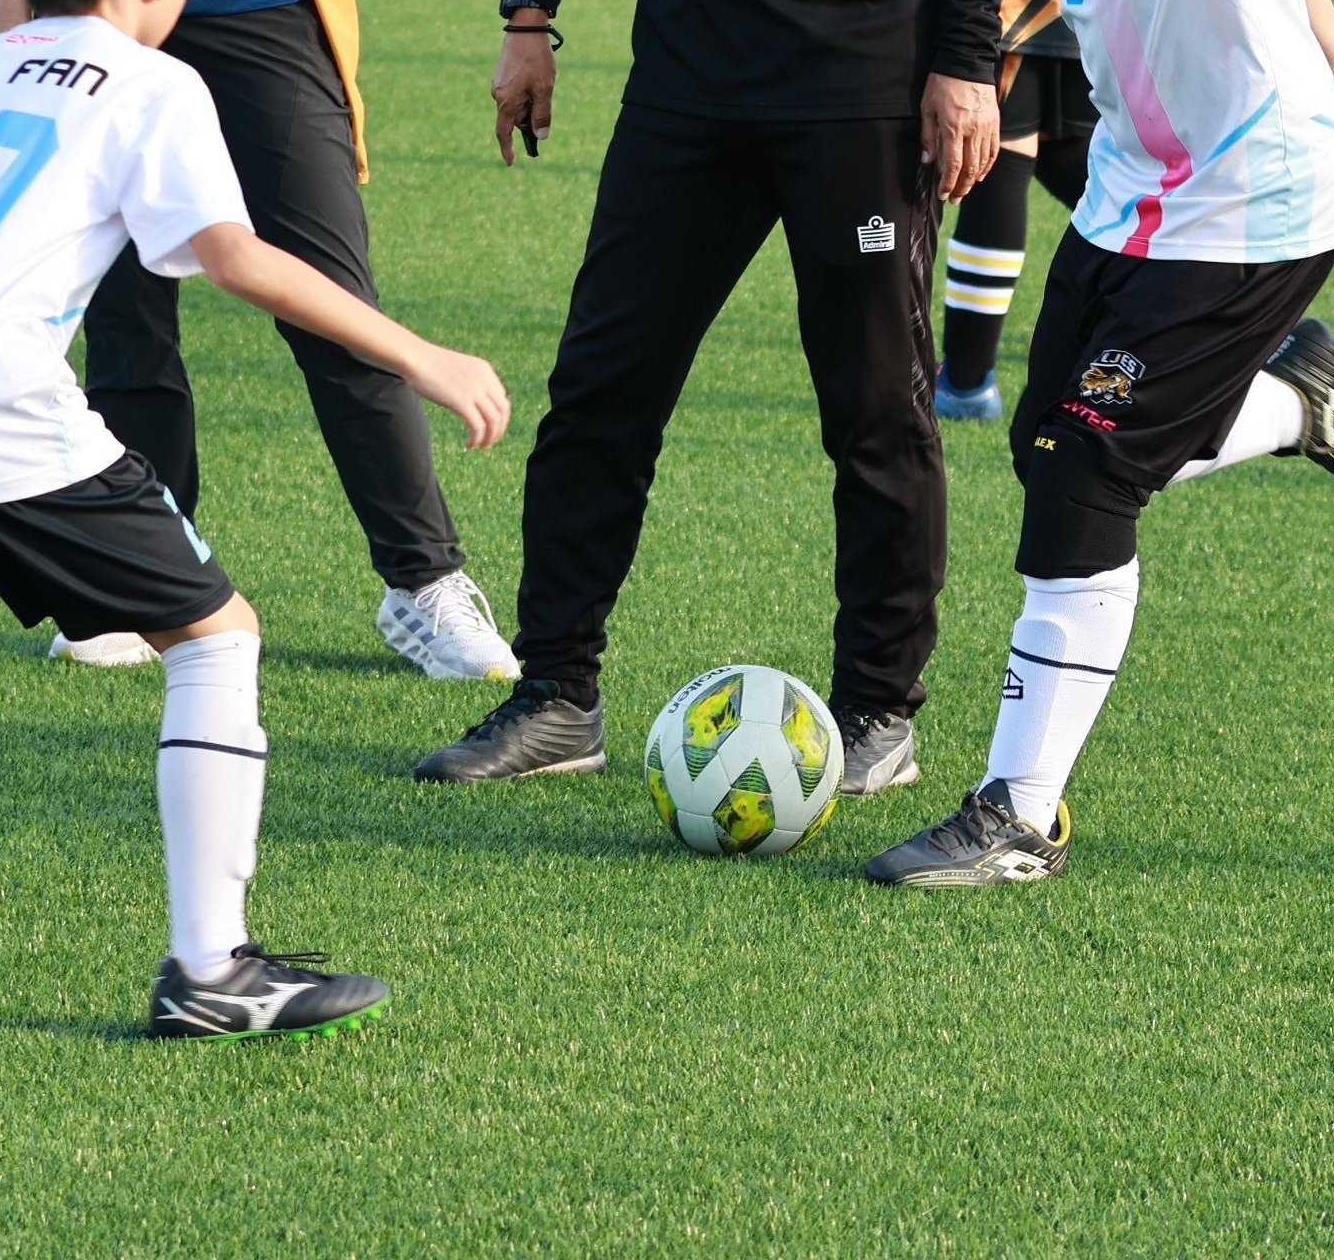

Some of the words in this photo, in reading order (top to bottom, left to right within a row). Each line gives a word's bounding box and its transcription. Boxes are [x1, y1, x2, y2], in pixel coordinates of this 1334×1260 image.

[7, 58, 109, 97] FAN
[863, 239, 892, 250] Admiral
[667, 667, 733, 715] molten
